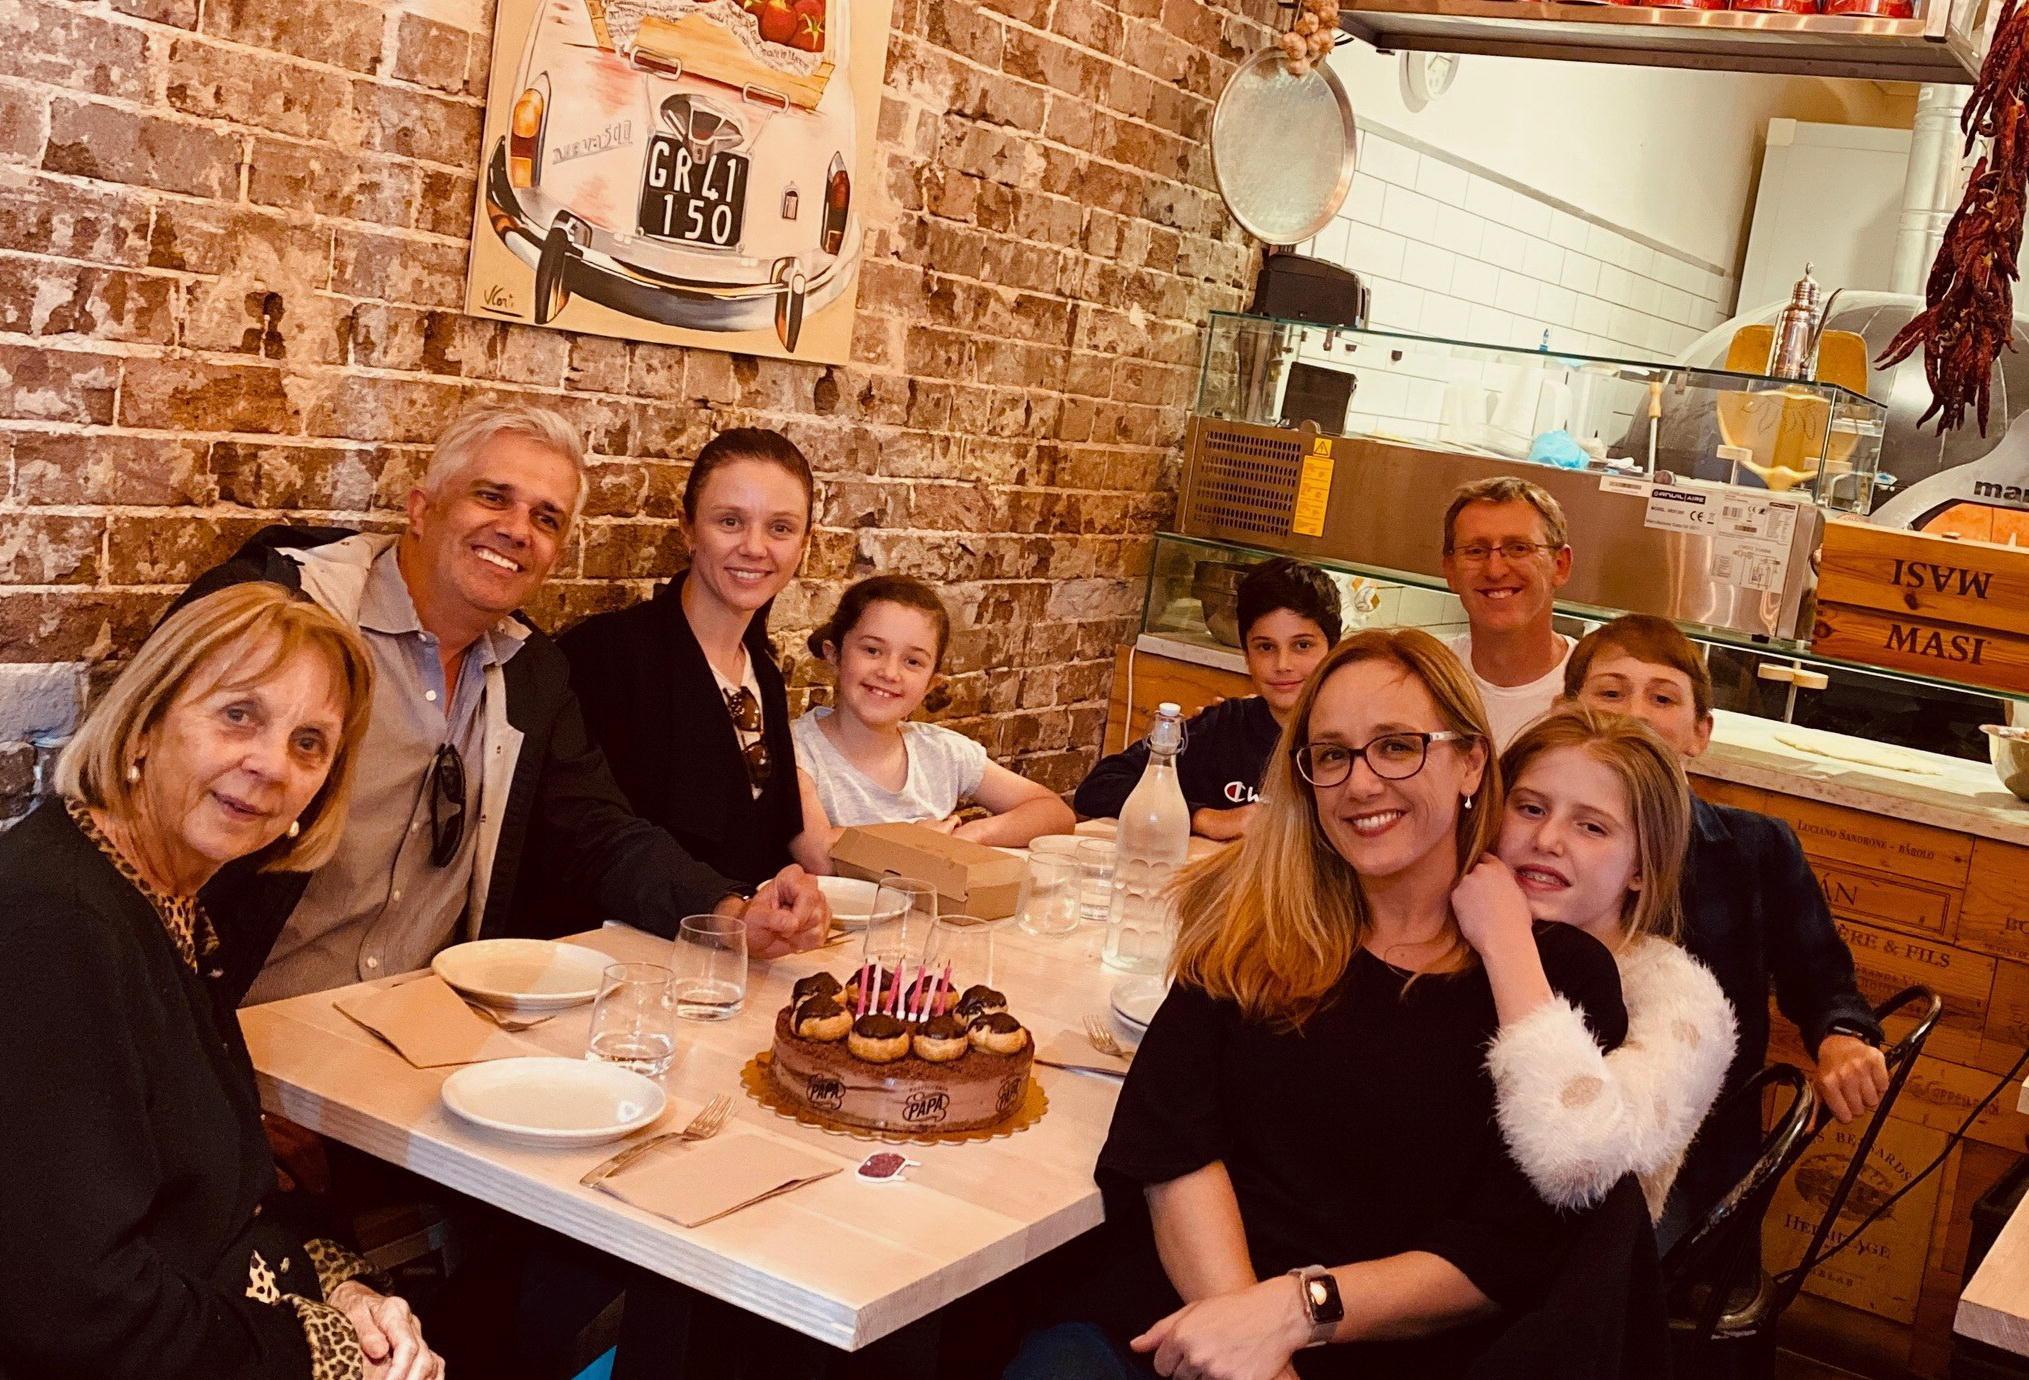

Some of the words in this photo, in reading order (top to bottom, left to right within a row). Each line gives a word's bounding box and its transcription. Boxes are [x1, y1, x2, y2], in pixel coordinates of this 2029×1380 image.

[663, 193, 733, 244] 150
[1889, 558, 1995, 600] MASI
[1882, 623, 1987, 666] MASI
[1904, 943, 1951, 969] FILS
[810, 1082, 840, 1101] PAPA
[908, 1095, 943, 1121] PAPA
